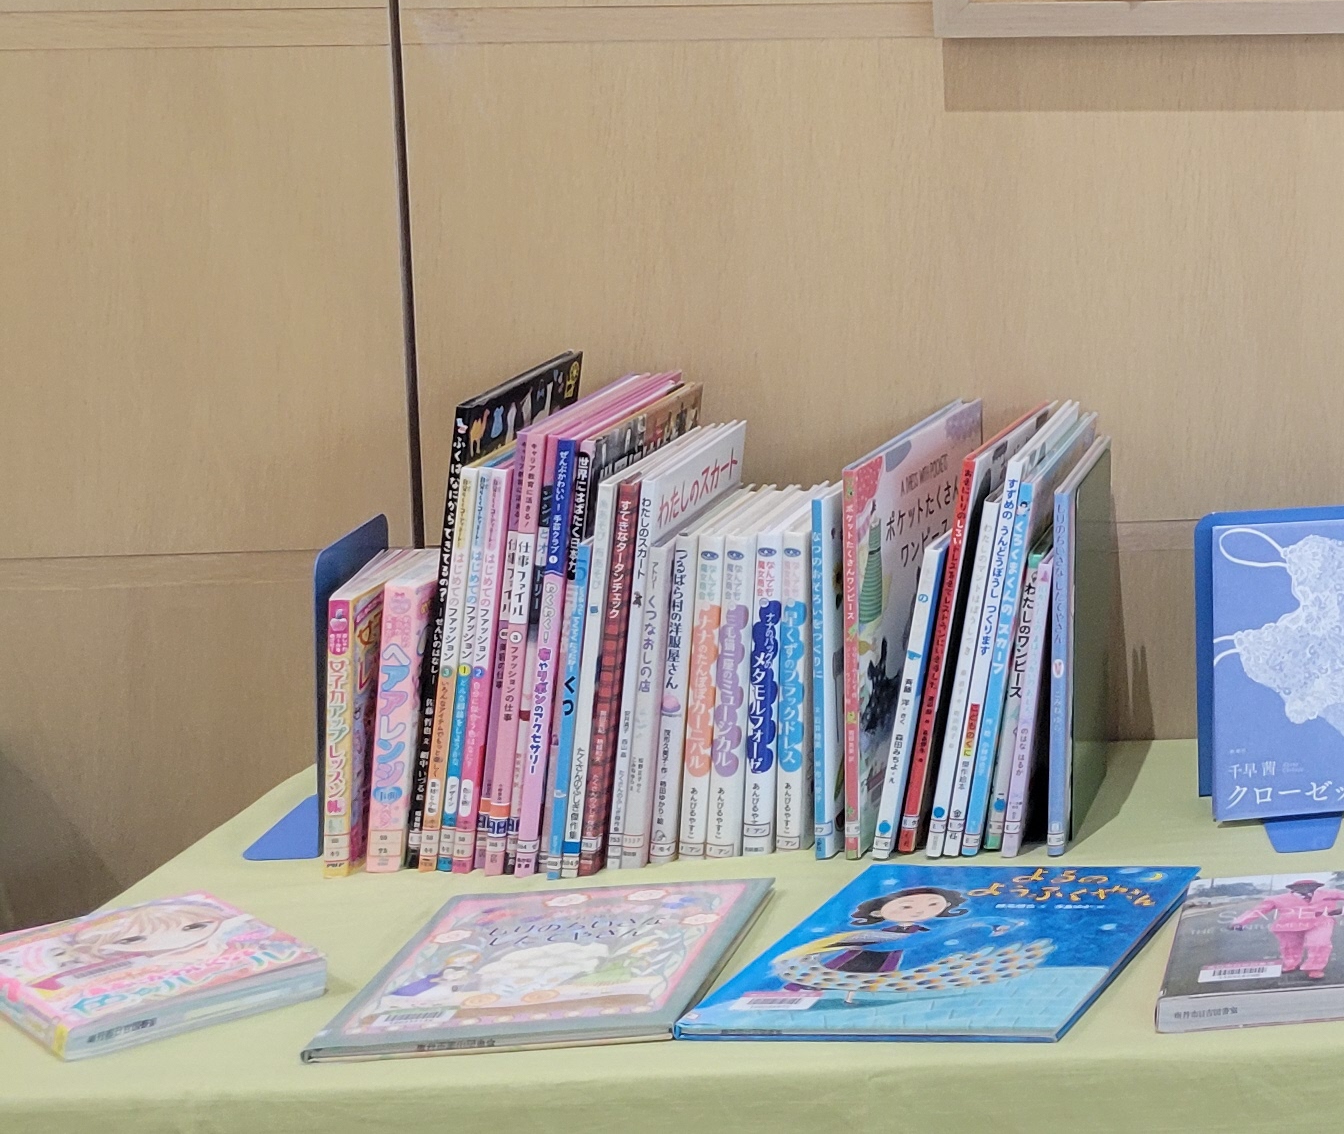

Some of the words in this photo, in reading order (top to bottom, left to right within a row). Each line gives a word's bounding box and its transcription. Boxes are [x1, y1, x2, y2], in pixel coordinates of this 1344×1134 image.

[656, 446, 739, 529] わたしのスカート
[885, 474, 960, 542] ポケットたくさん
[1002, 478, 1019, 519] すずめの
[512, 540, 532, 617] 仕事ファイル
[607, 499, 633, 619] すてきなタータンチェック
[636, 497, 652, 580] わたしのスカート
[845, 504, 855, 621] ポケットたくさんワンピース
[989, 525, 1010, 599] うんどうぼうし
[1001, 520, 1027, 616] くろくまくんの
[443, 552, 464, 662] はじめてのファッション
[461, 552, 482, 660] はじめてのファッション
[475, 553, 496, 663] はじめてのファッション
[764, 561, 775, 597] なんでも
[811, 531, 823, 679] なつのおそろいをつくりに
[639, 595, 658, 694] くつなおしの店
[665, 549, 688, 690] つるばら村の洋服屋さん
[979, 605, 997, 657] つくります
[992, 623, 1010, 675] スカーフ
[1009, 583, 1037, 699] わたしのワンピース
[503, 646, 519, 722] ファッションの仕事
[561, 676, 577, 717] くつ
[690, 615, 712, 769] ナナのたんぽぽカーニバル
[716, 615, 738, 767] 三毛猫一座のミュージカル
[750, 652, 767, 774] メタモルフォーゼ
[782, 610, 800, 765] 星くずのブラックドレス
[963, 704, 981, 757] こどものくに
[783, 782, 792, 834] あんびるやすこ
[1228, 762, 1258, 780] 千早
[687, 787, 698, 839] あんびるやすこ
[715, 787, 725, 839] あんびるやすこ
[967, 882, 1157, 908] ようふくやさん
[1012, 868, 1110, 884] よるの
